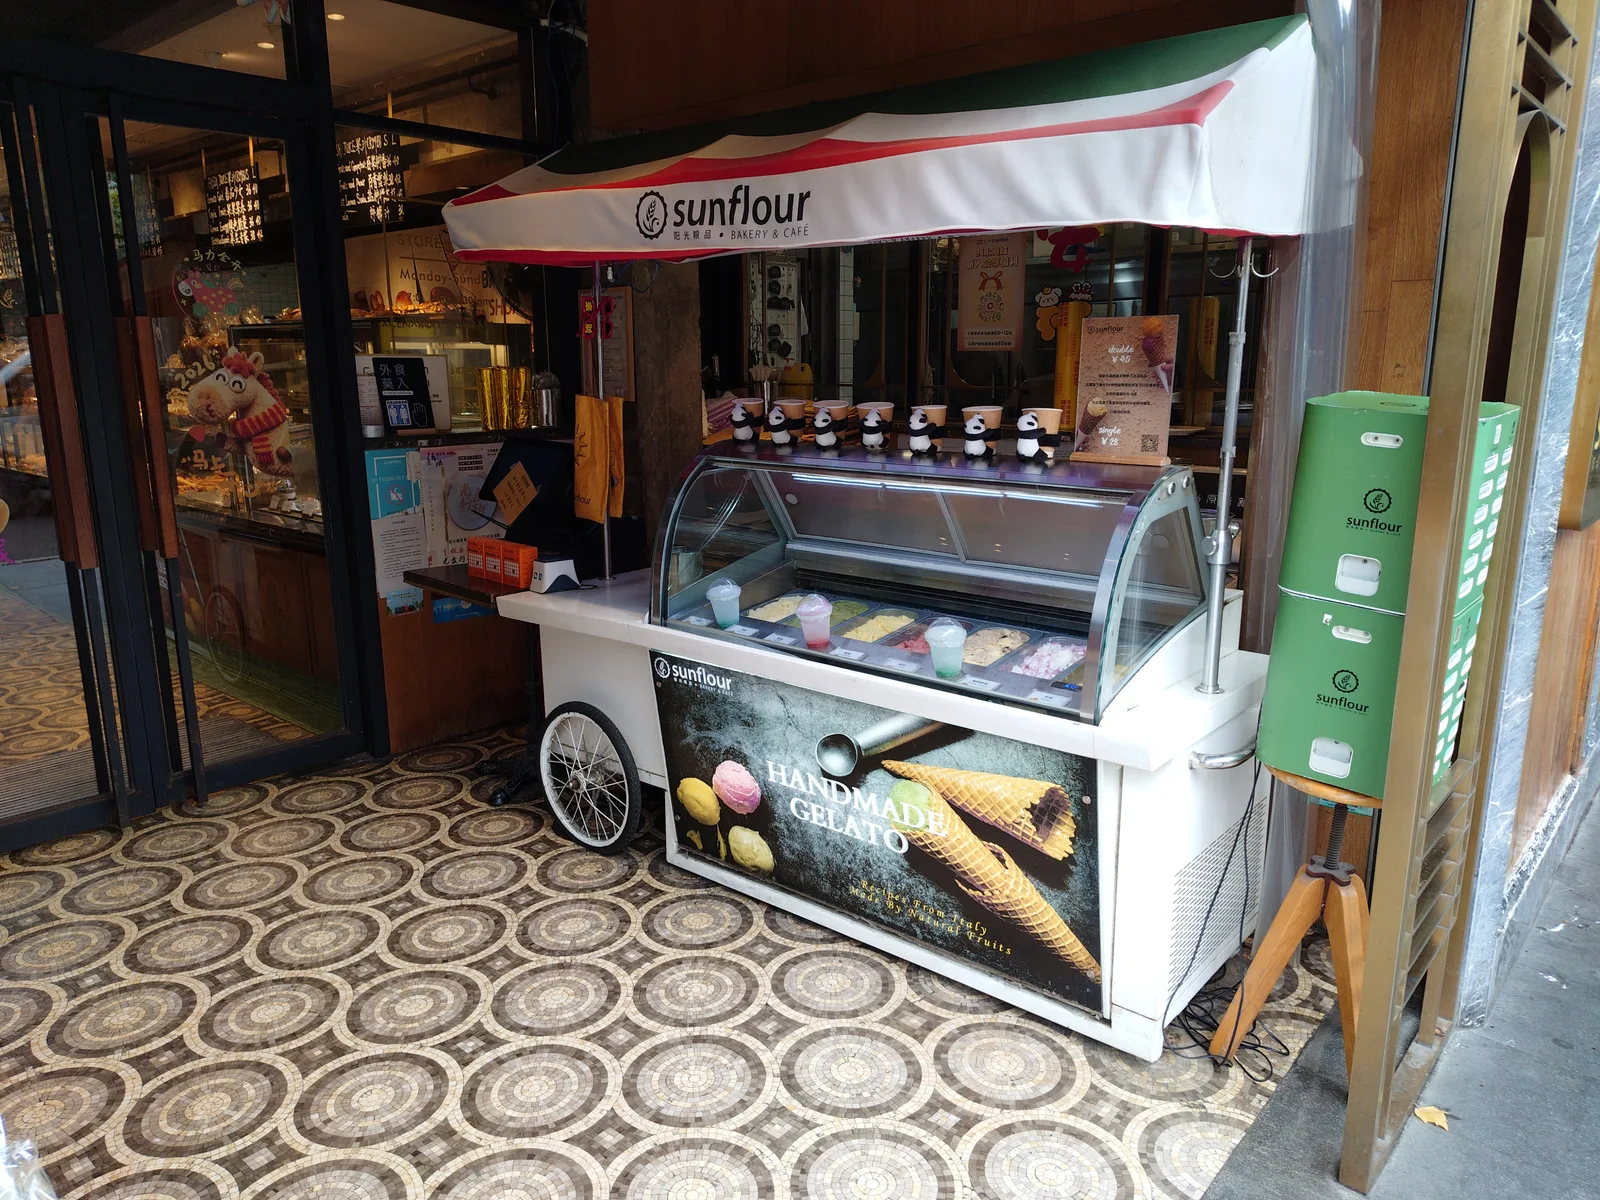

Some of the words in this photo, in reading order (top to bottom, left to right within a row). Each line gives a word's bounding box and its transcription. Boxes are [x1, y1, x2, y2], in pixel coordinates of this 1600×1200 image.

[673, 184, 811, 228] sunflour
[673, 229, 712, 241] 阳光粮品
[730, 229, 769, 240] BAKERY
[772, 229, 779, 239] &
[783, 223, 809, 238] CAFÉ
[396, 233, 443, 250] STORE
[192, 248, 243, 272] 马力全开
[400, 268, 481, 286] Monday-Sund
[1096, 326, 1124, 334] sunflour
[1108, 344, 1135, 354] double
[1111, 355, 1118, 363] ¥
[1120, 355, 1131, 363] 45
[174, 354, 216, 390] 2026
[379, 363, 406, 376] 外食
[1098, 426, 1122, 438] single
[1101, 438, 1108, 446] ¥
[1109, 438, 1119, 446] 28
[1346, 516, 1403, 533] sunflour
[672, 664, 732, 691] sunflour
[1316, 693, 1370, 713] sunflour
[766, 760, 950, 837] HANDMADE
[789, 797, 911, 854] GELATO
[860, 880, 907, 905] Recipes
[912, 899, 945, 919] From
[951, 911, 988, 936] Italy
[849, 886, 880, 904] Made
[886, 900, 902, 914] By
[908, 909, 961, 935] Natural
[967, 930, 1013, 956] Fruits
